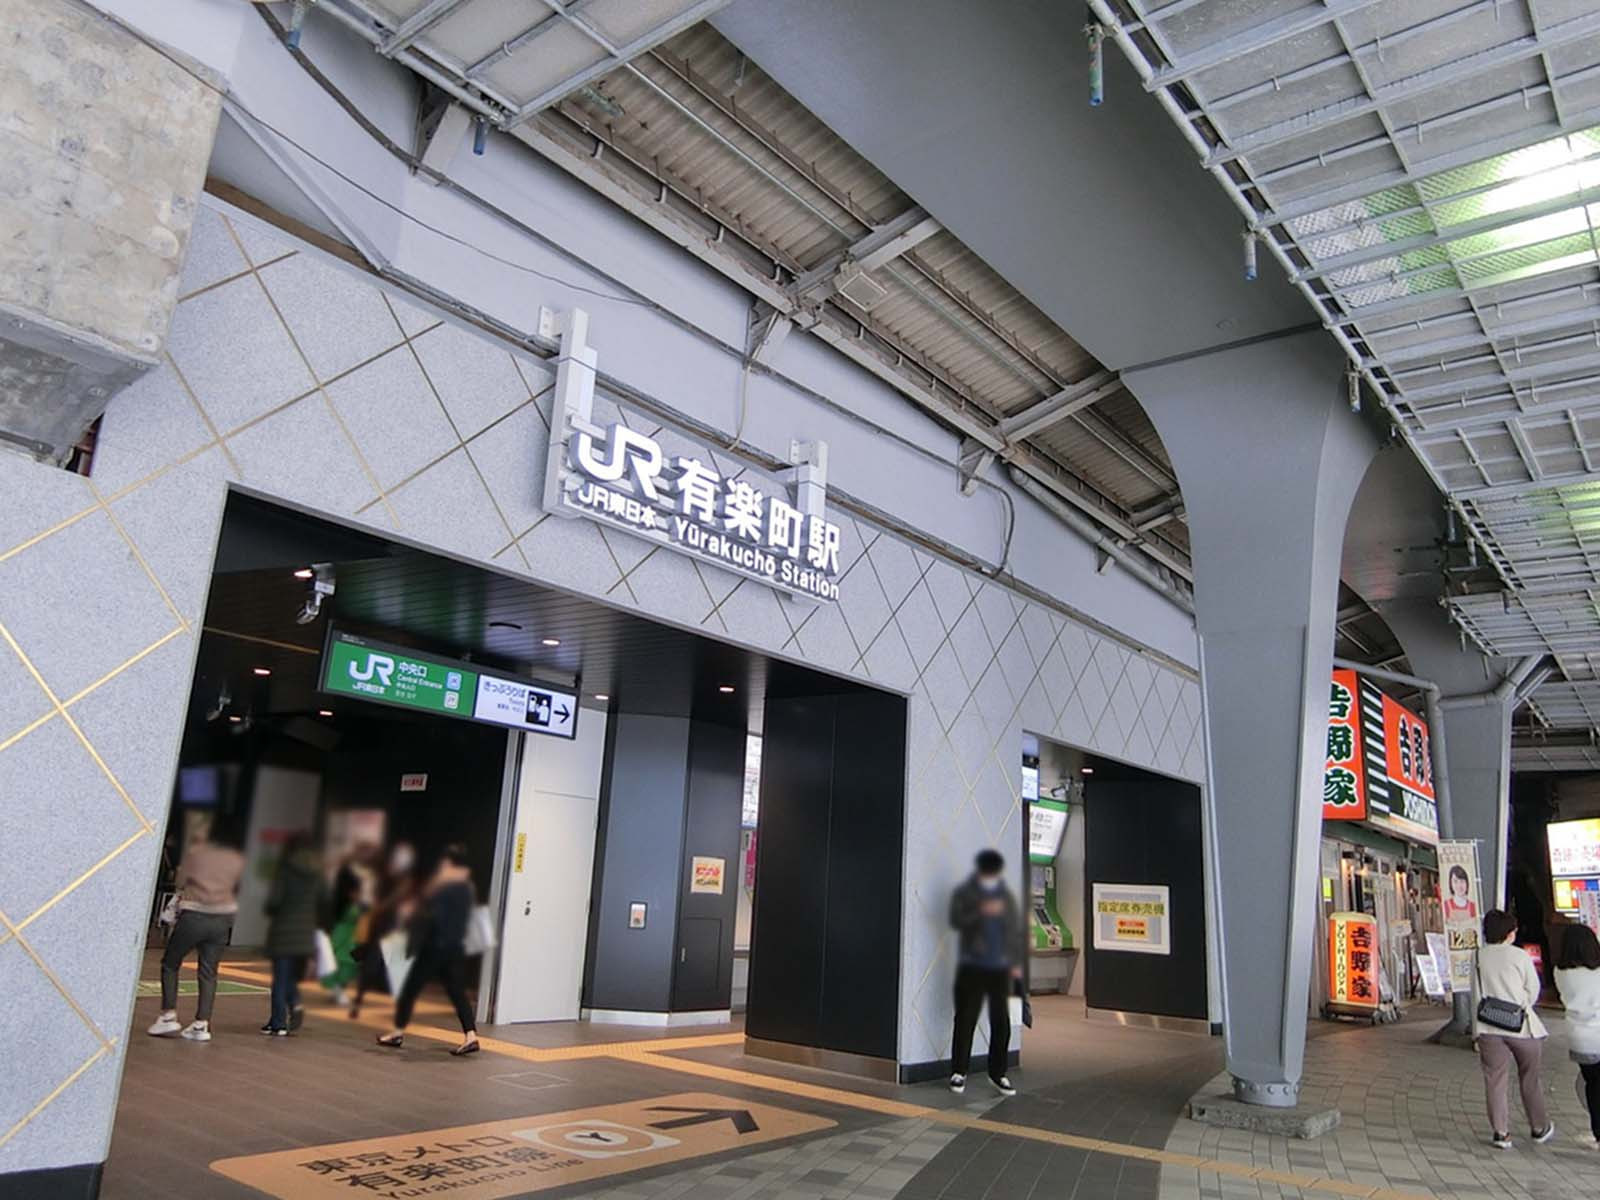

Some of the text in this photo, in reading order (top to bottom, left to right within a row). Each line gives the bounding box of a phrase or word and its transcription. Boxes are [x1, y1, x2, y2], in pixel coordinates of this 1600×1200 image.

[573, 423, 662, 500] JR
[577, 484, 657, 528] JR東日本
[676, 456, 841, 574] 有楽町駅
[675, 514, 841, 600] Yūrakuchō Station
[349, 653, 395, 687] JR
[398, 661, 428, 678] 中央口
[1351, 926, 1372, 998] 吉野家
[296, 1135, 513, 1175] 東京メトロ
[334, 1147, 557, 1190] 有楽町線
[527, 1157, 584, 1173] Line
